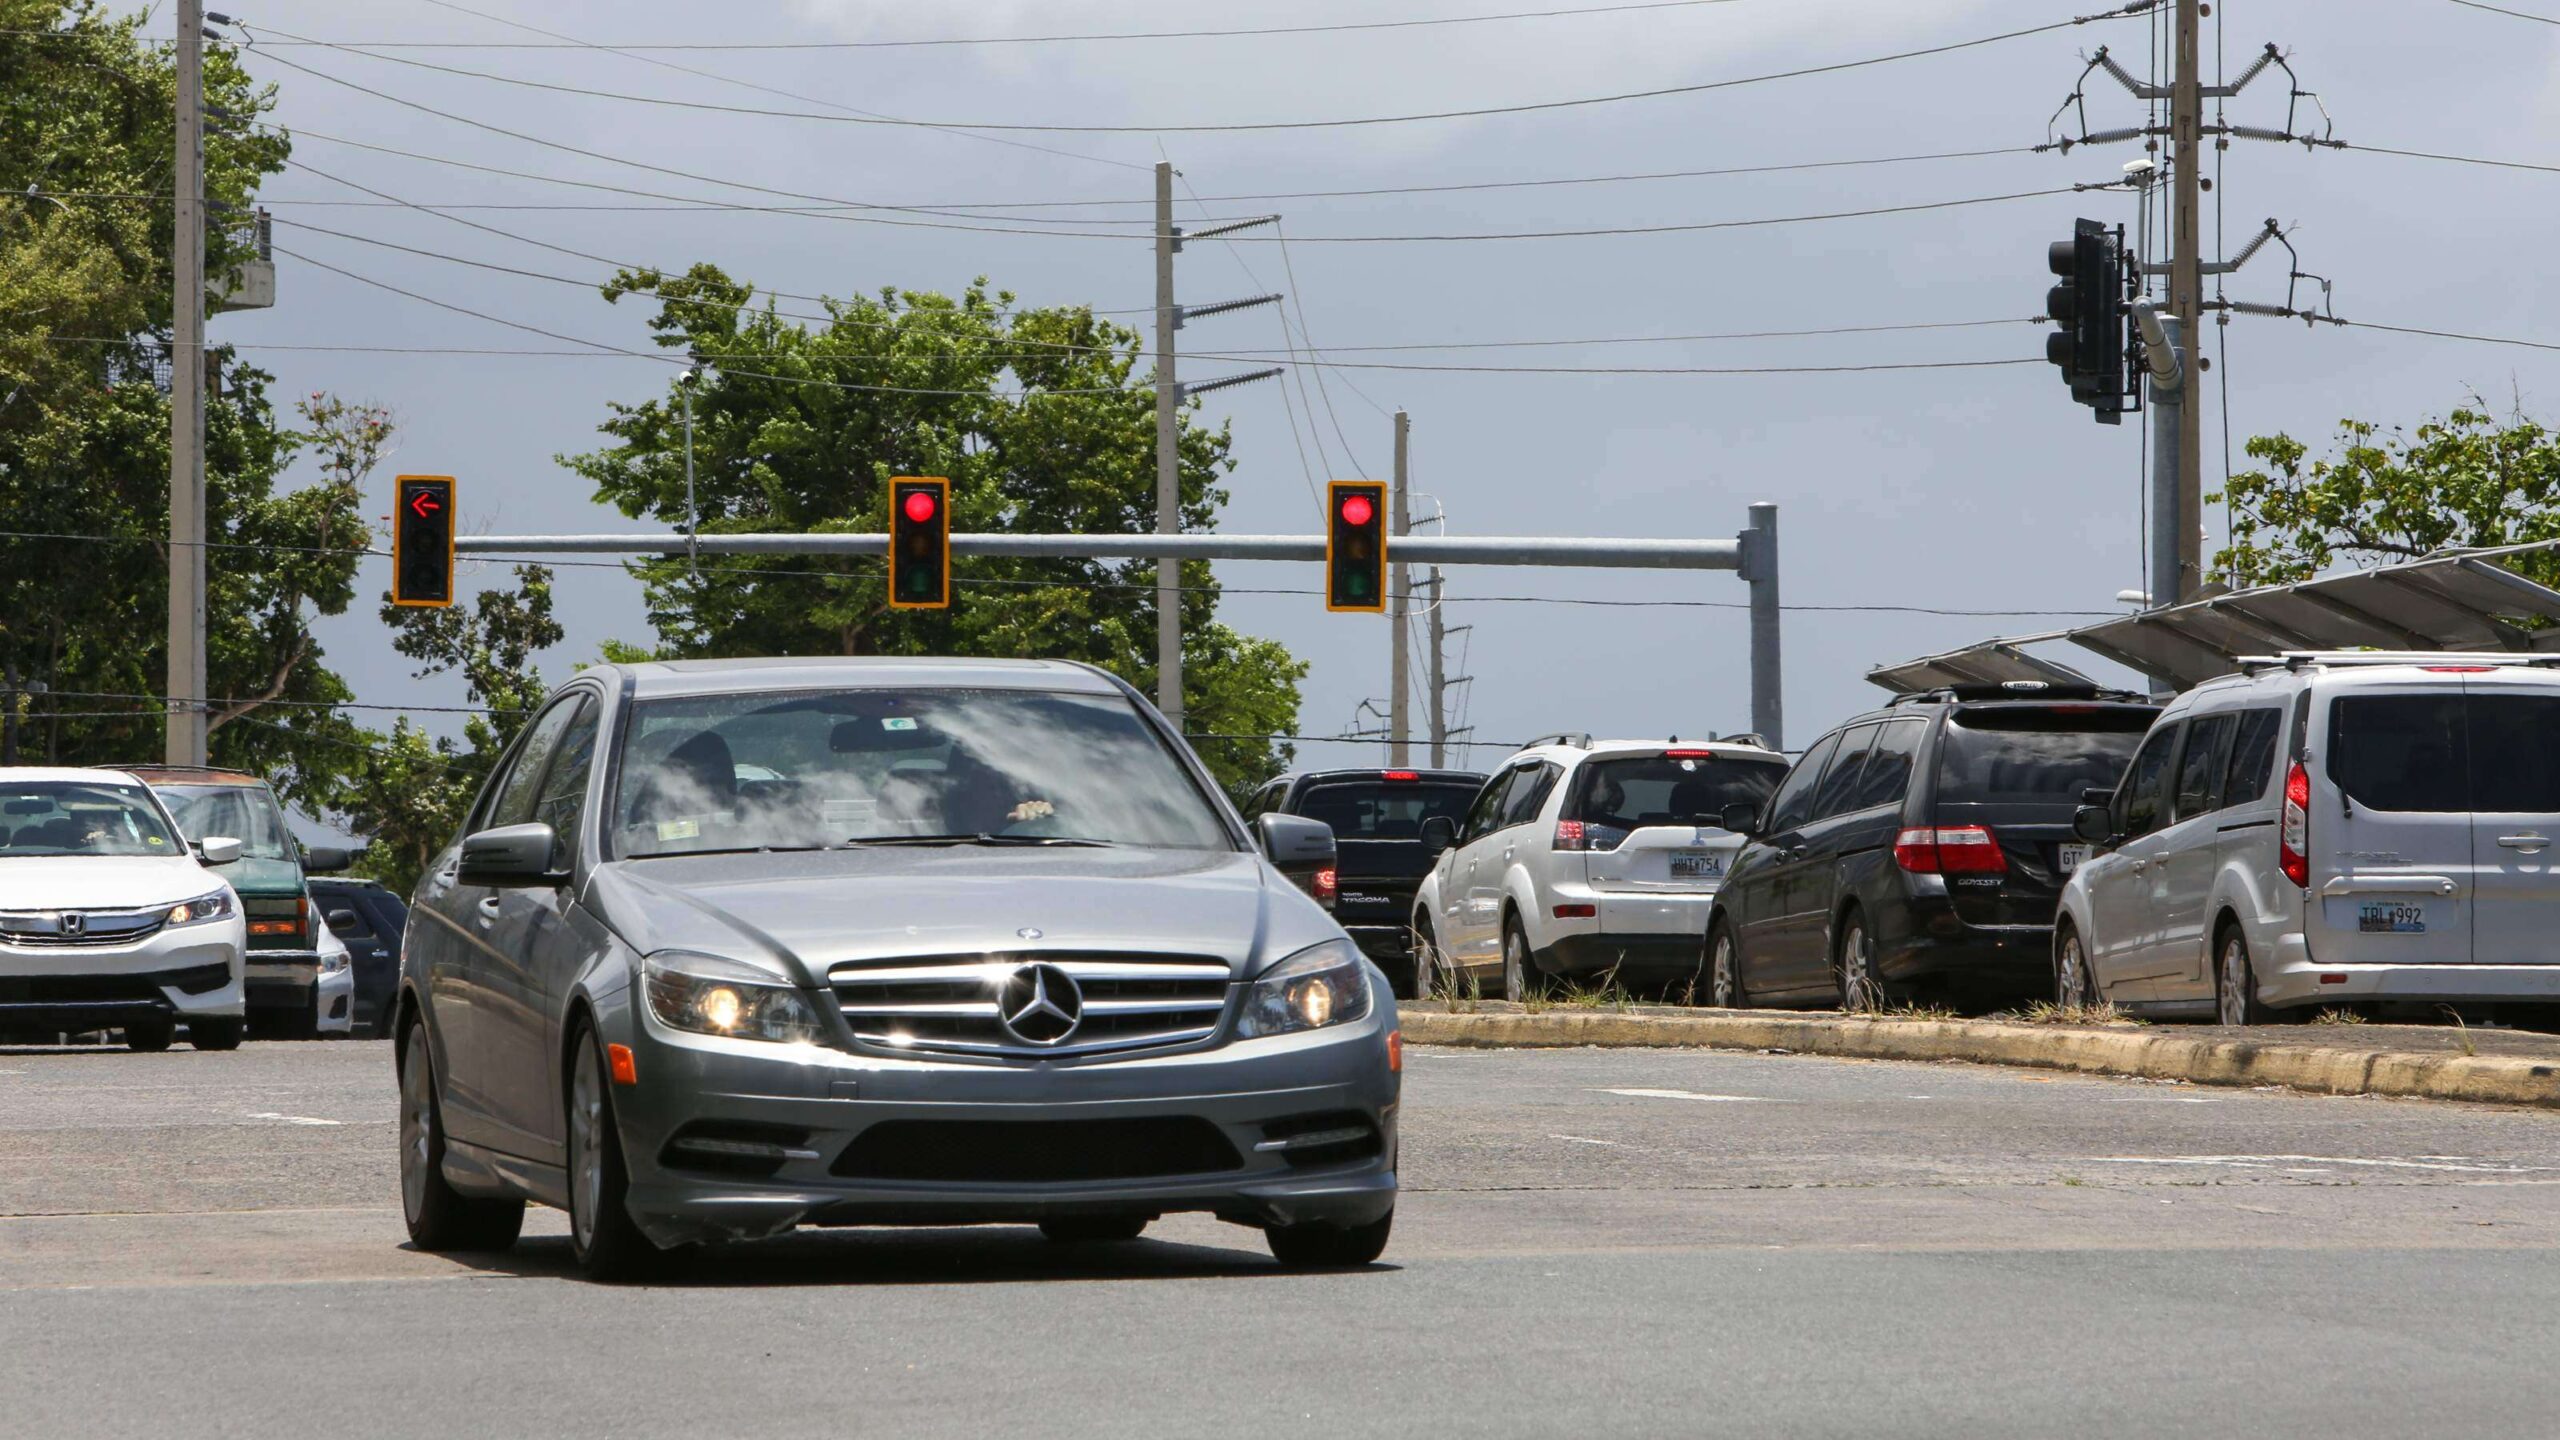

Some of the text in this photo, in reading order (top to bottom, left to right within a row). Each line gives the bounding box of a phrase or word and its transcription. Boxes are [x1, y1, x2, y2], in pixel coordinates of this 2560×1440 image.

[1699, 857, 1719, 871] 754
[2063, 851, 2083, 865] GT
[1958, 878, 2003, 886] ODYSSEY
[2396, 906, 2421, 925] 992
